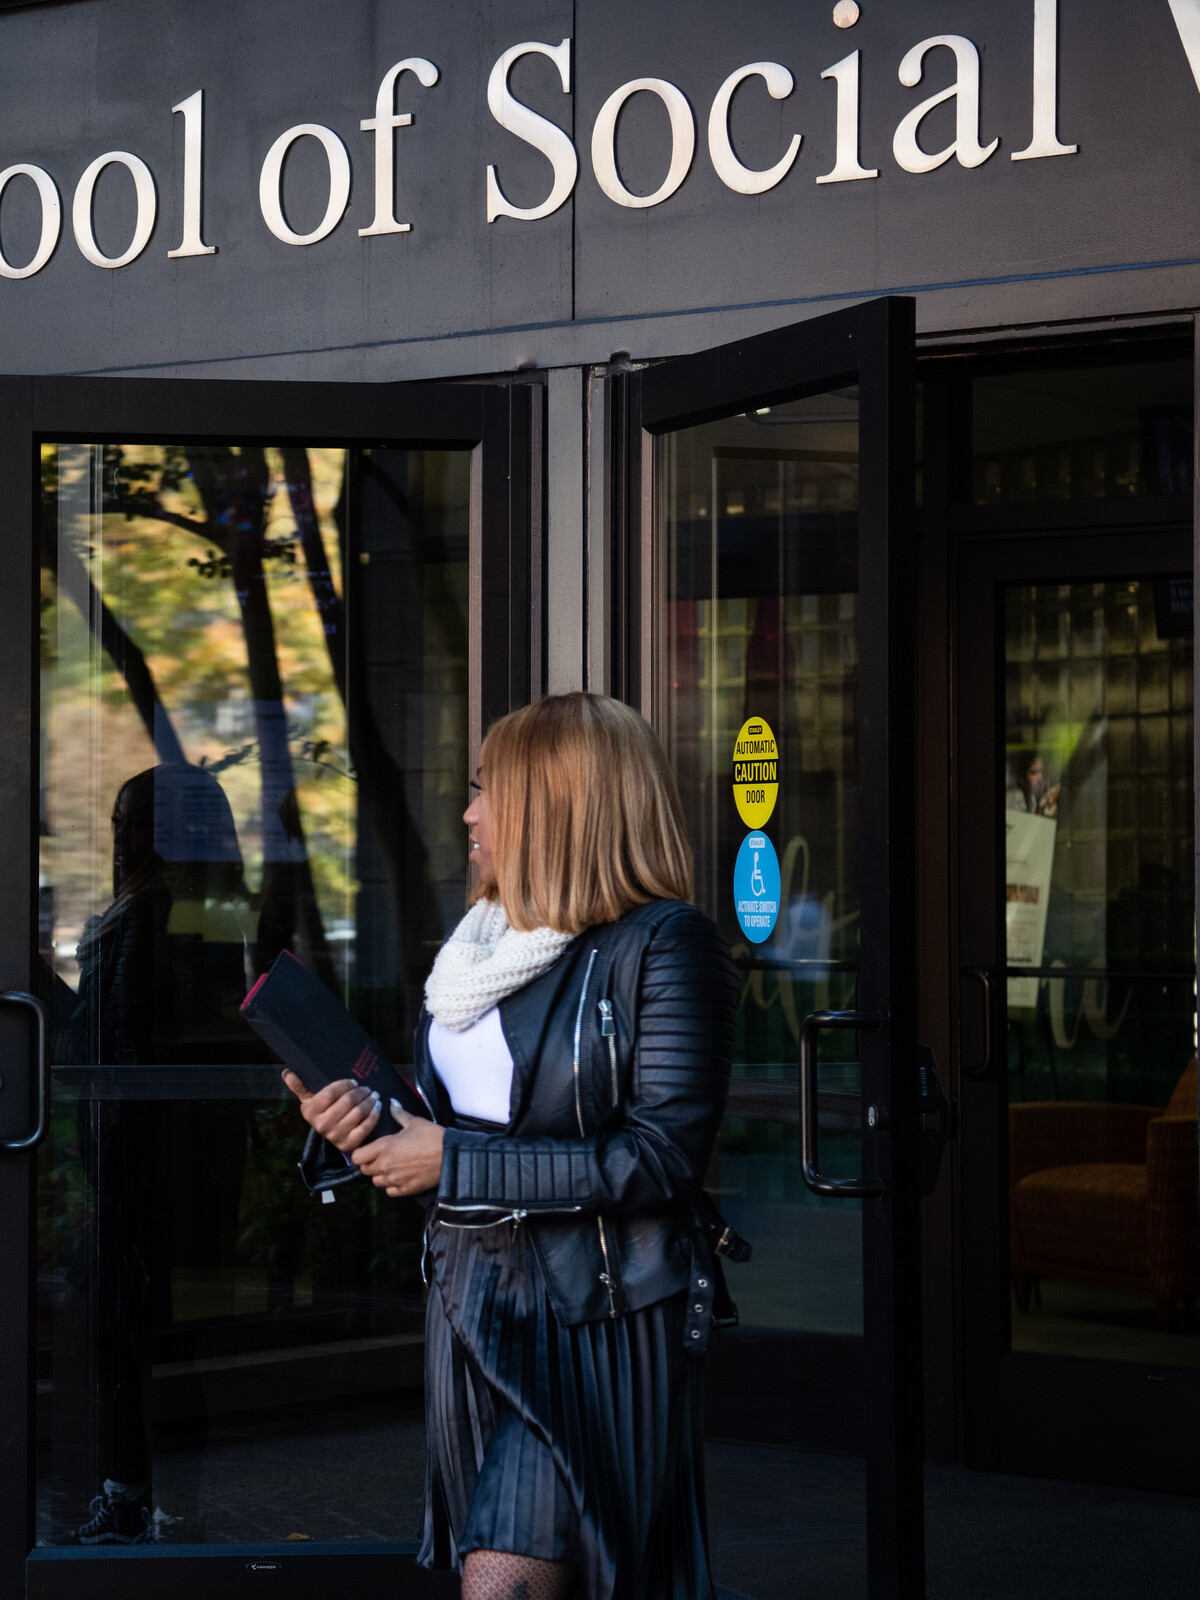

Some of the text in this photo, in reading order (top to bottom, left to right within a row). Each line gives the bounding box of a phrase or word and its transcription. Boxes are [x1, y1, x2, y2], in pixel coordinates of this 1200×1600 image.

[258, 57, 440, 246] of
[487, 0, 1078, 224] Social
[736, 740, 775, 755] AUTOMATIC
[734, 762, 777, 782] CAUTION
[746, 790, 766, 803] DOOR
[738, 900, 777, 913] ACTIVATE SWITCH
[744, 915, 770, 927] TO OPERATE
